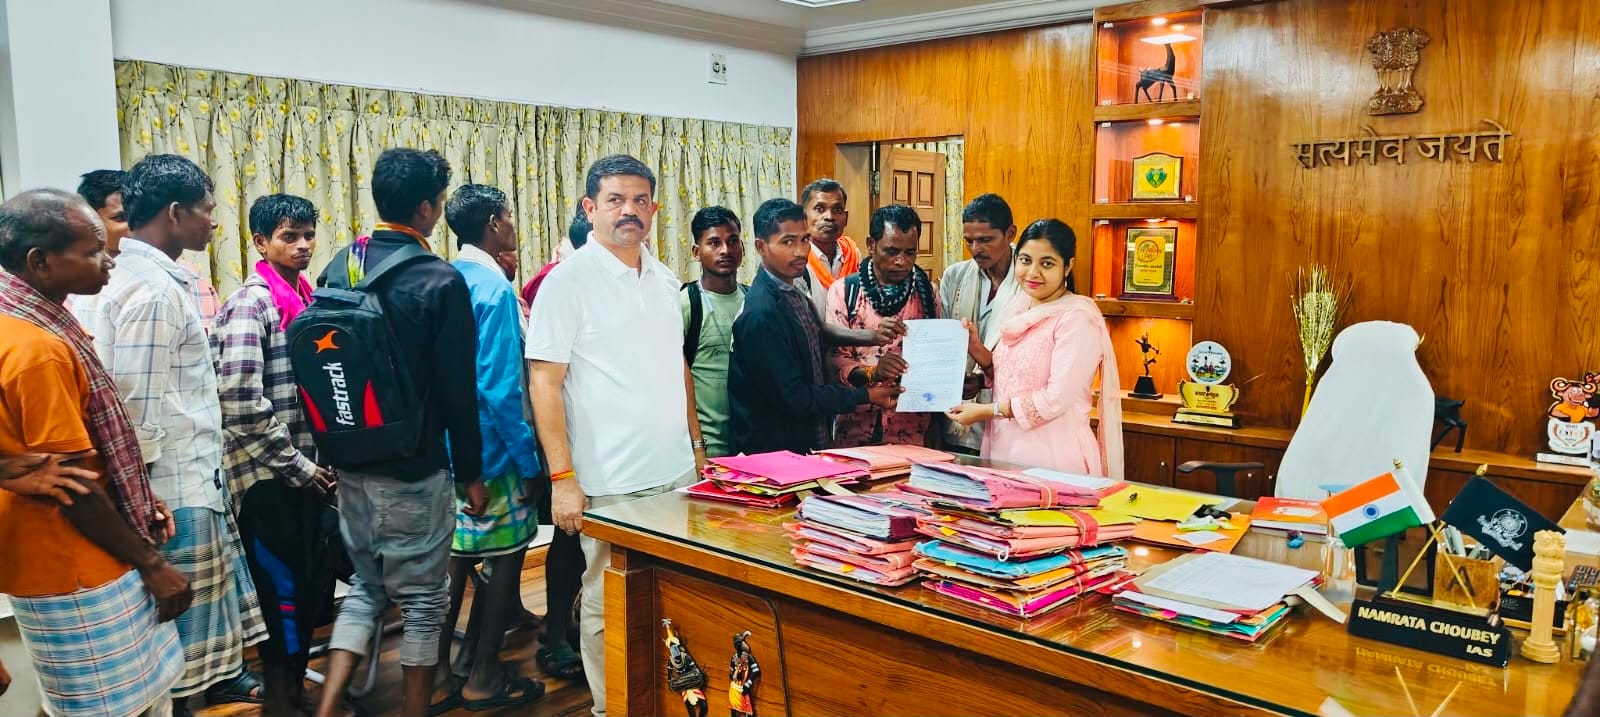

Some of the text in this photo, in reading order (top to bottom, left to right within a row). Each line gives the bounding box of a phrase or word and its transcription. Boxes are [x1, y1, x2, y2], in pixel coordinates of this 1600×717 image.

[1291, 119, 1512, 169] सत्यमेव जयते
[322, 362, 355, 426] fastrack
[1357, 606, 1501, 645] NAMRATA CHOUBEY
[1466, 644, 1494, 658] IAS
